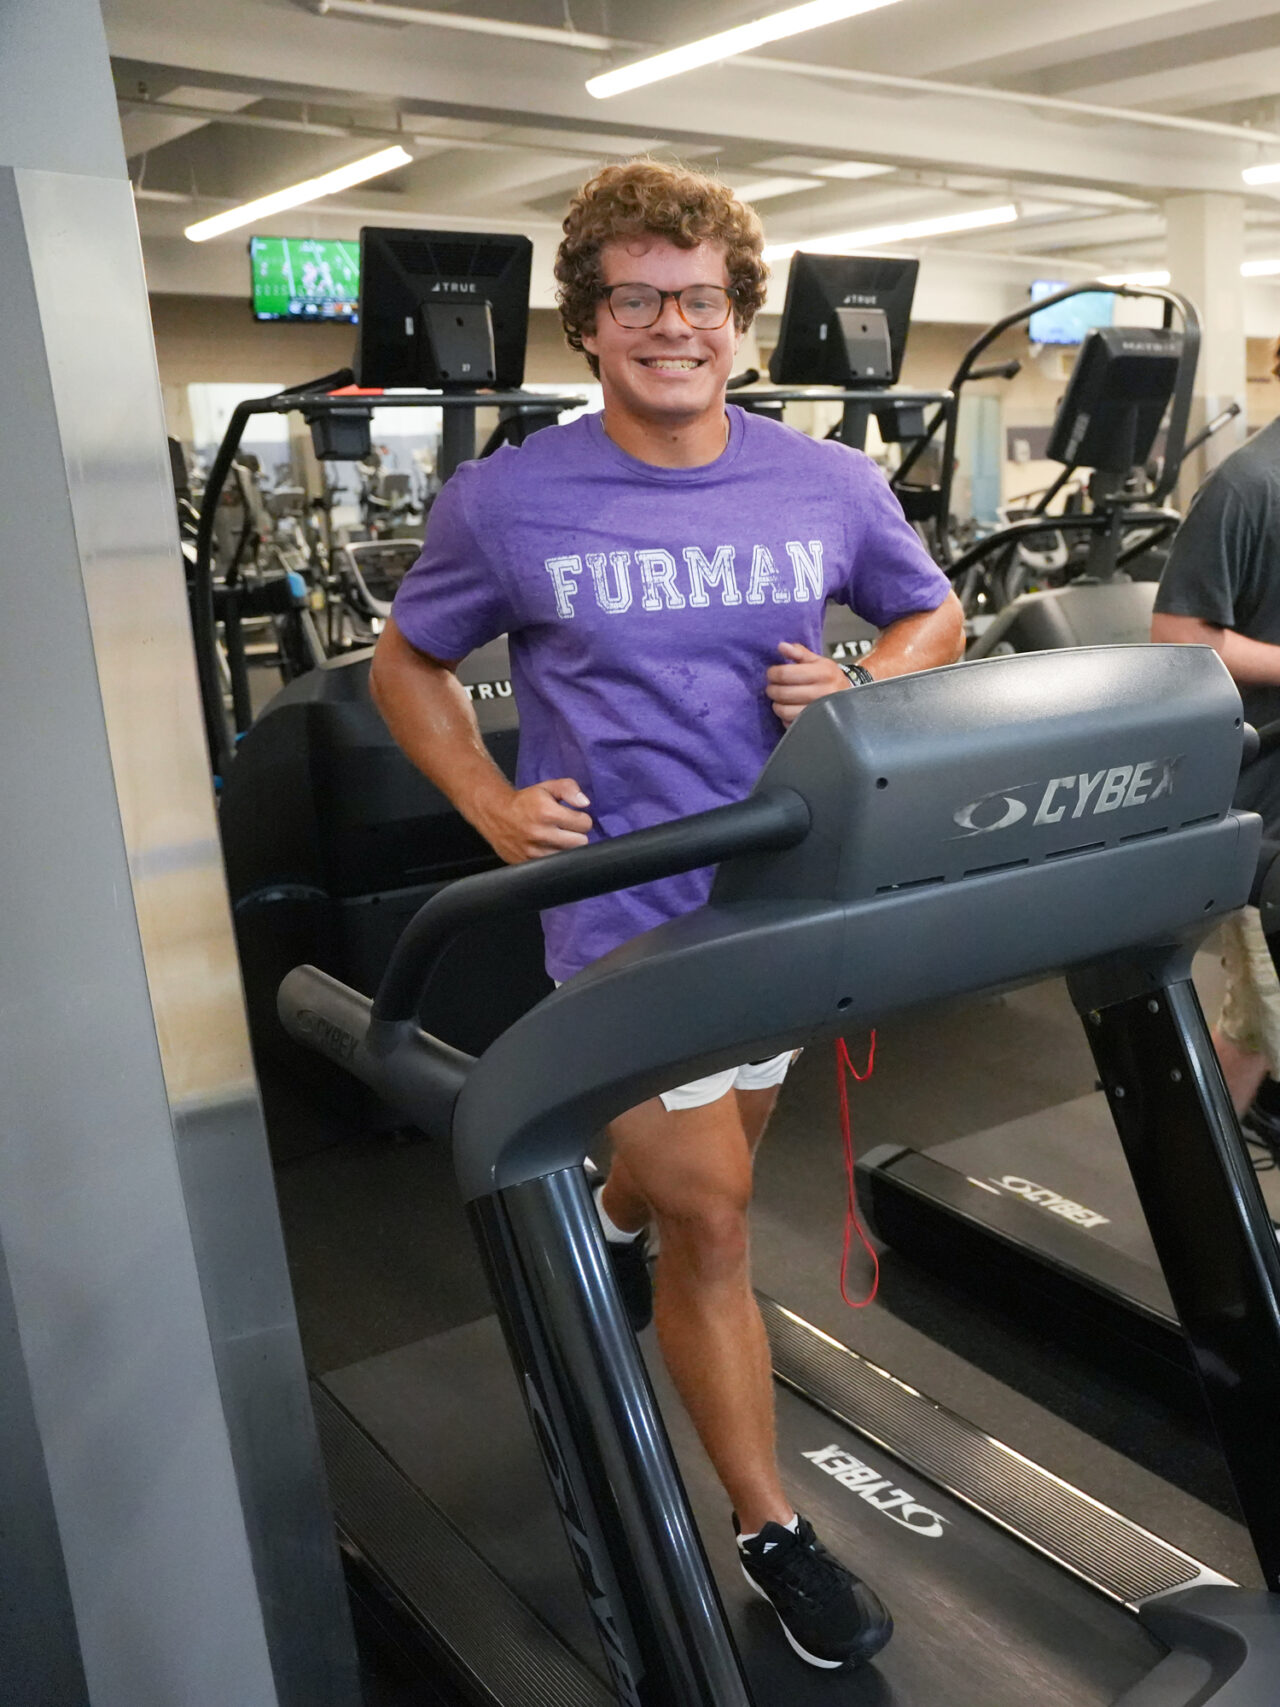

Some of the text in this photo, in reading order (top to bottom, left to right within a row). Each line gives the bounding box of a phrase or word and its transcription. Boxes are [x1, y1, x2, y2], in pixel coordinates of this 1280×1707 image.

[442, 281, 477, 293] TRUE
[545, 540, 823, 618] FURMAN
[463, 680, 512, 701] TRU
[1032, 754, 1187, 827] CYBEX
[1022, 1188, 1111, 1229] CYBEX
[800, 1443, 917, 1511] CYBEX
